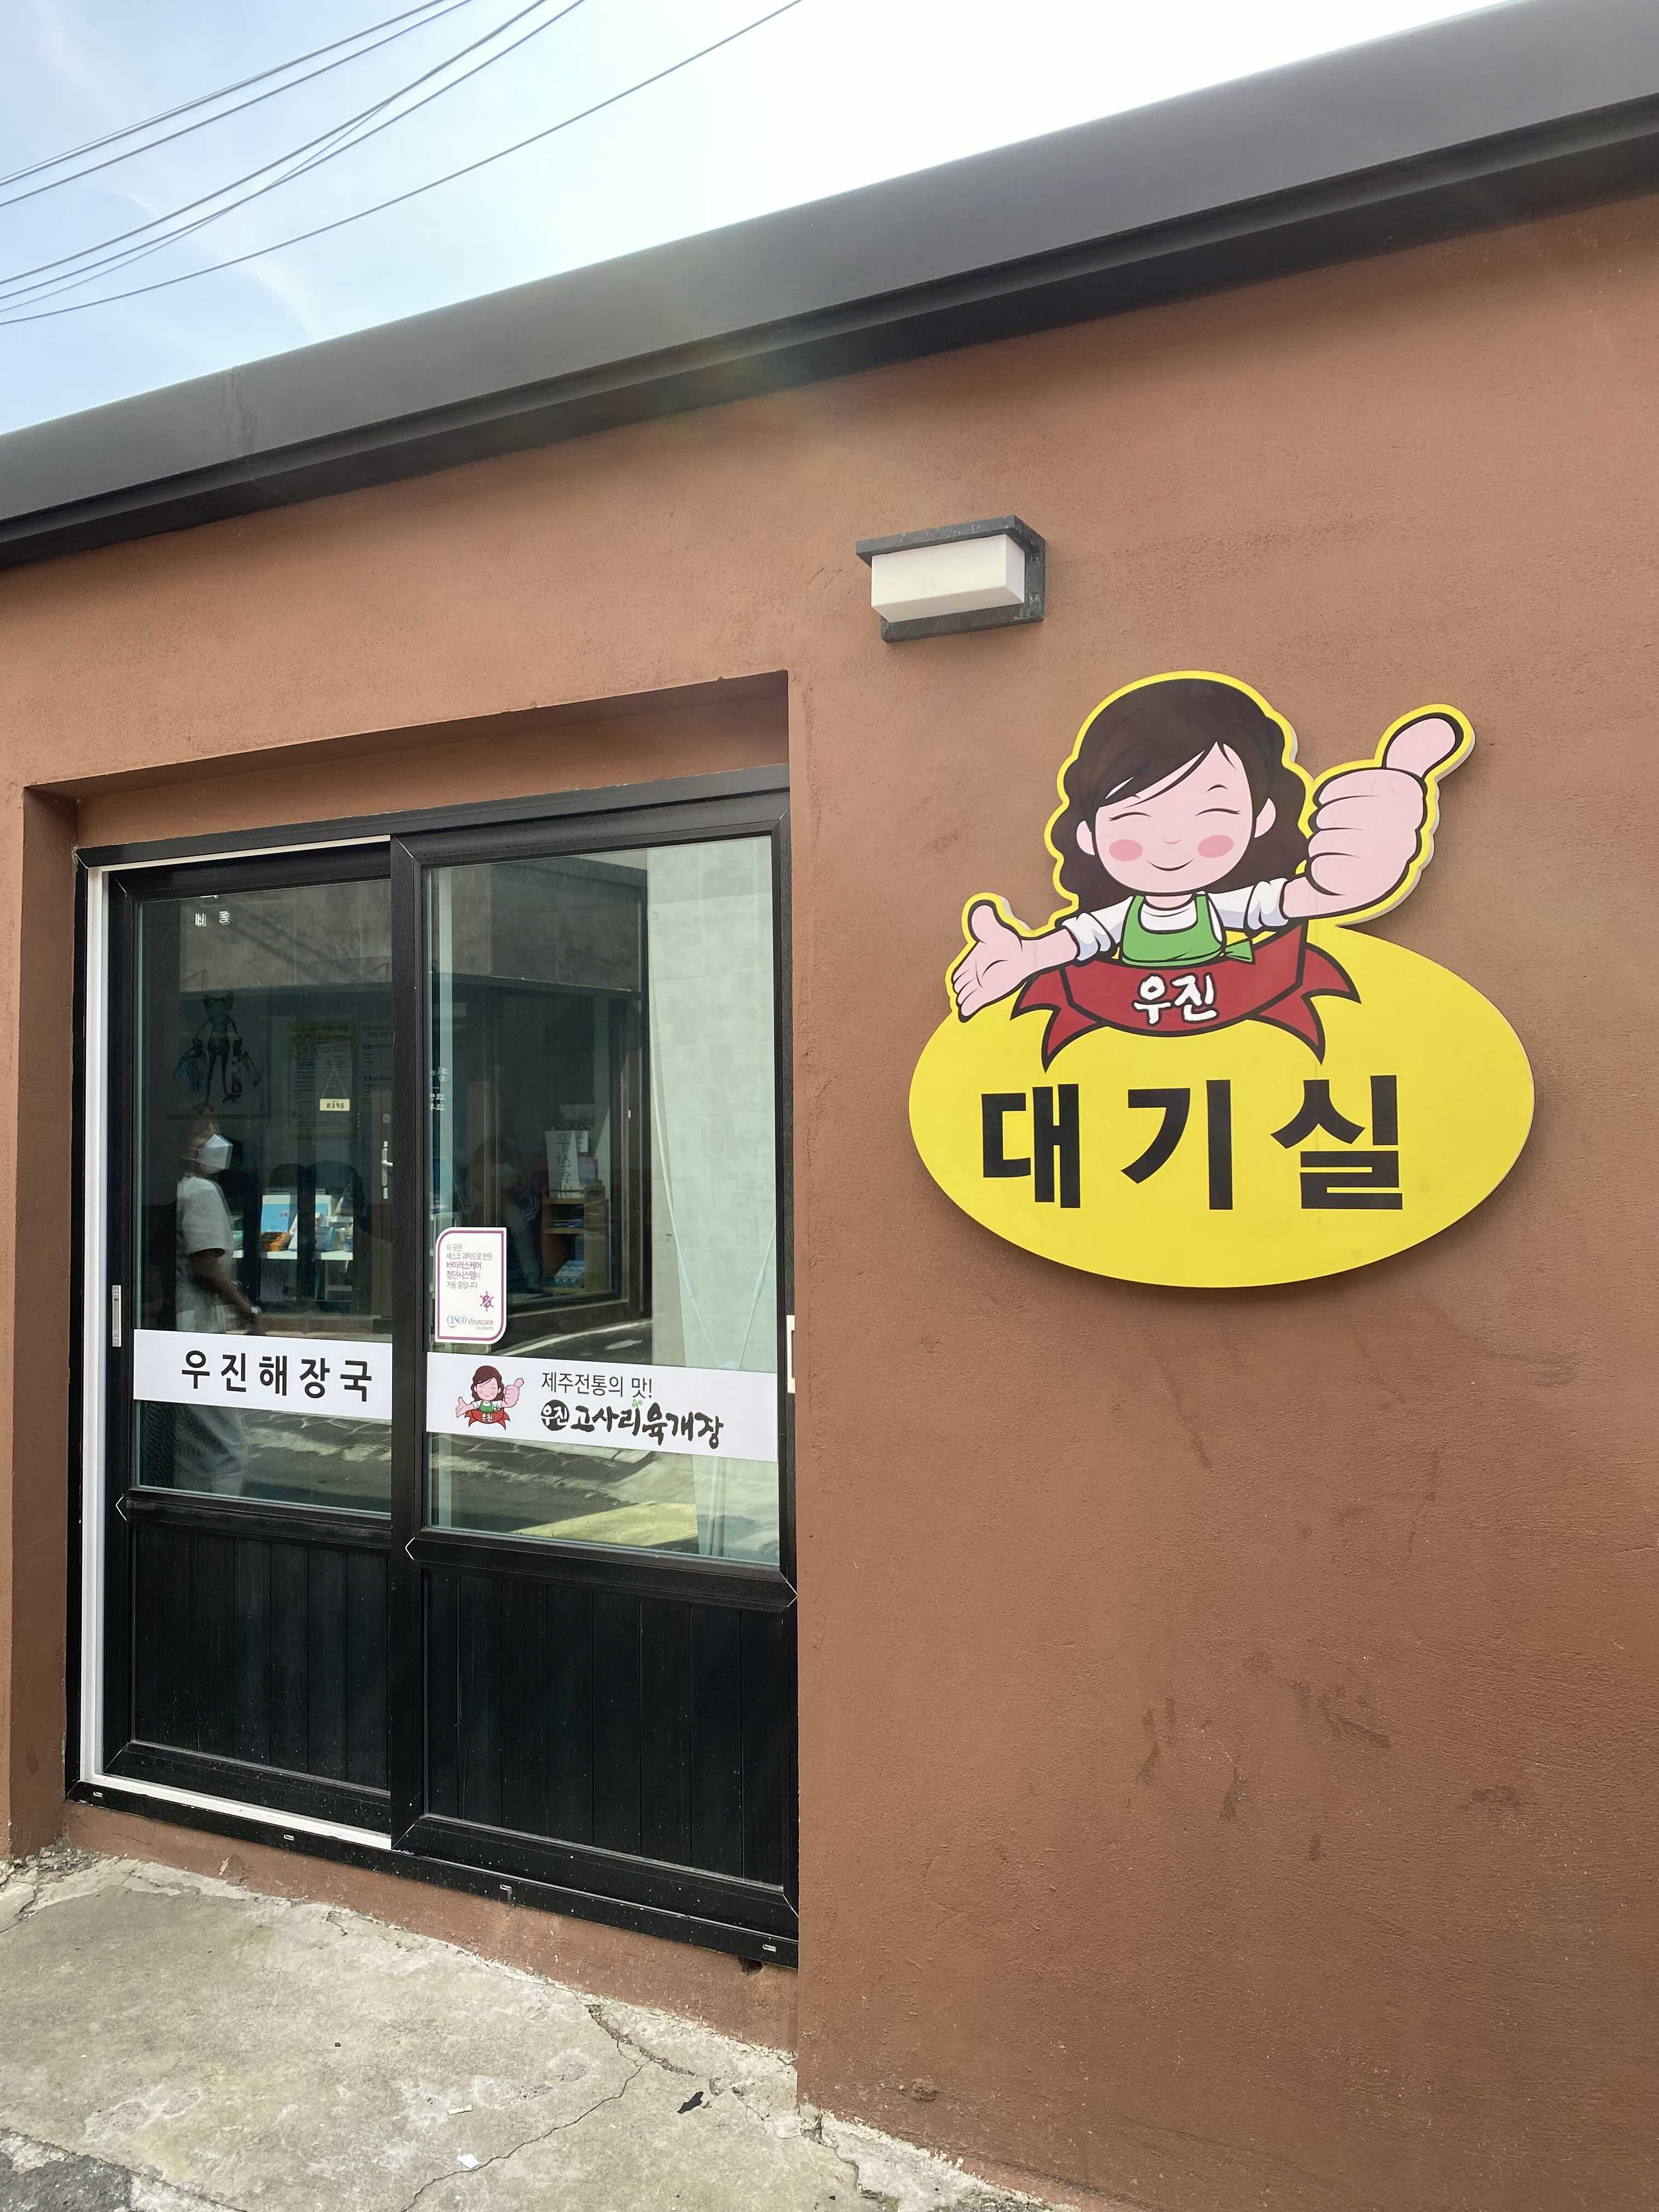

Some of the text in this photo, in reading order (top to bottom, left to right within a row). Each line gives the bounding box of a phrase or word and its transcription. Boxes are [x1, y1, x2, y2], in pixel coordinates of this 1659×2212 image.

[1134, 974, 1218, 1023] 우진
[981, 1075, 1403, 1211] 대기실
[447, 1261, 482, 1270] 바이러스케어
[447, 1271, 481, 1280] 첨단시스템이
[447, 1316, 494, 1326] CESCO Viruscare
[182, 1350, 373, 1402] 우진해장국
[541, 1372, 652, 1399] 제주전통의 맛!
[482, 1413, 493, 1422] 우진
[541, 1400, 724, 1449] 우진 고사리육개장
